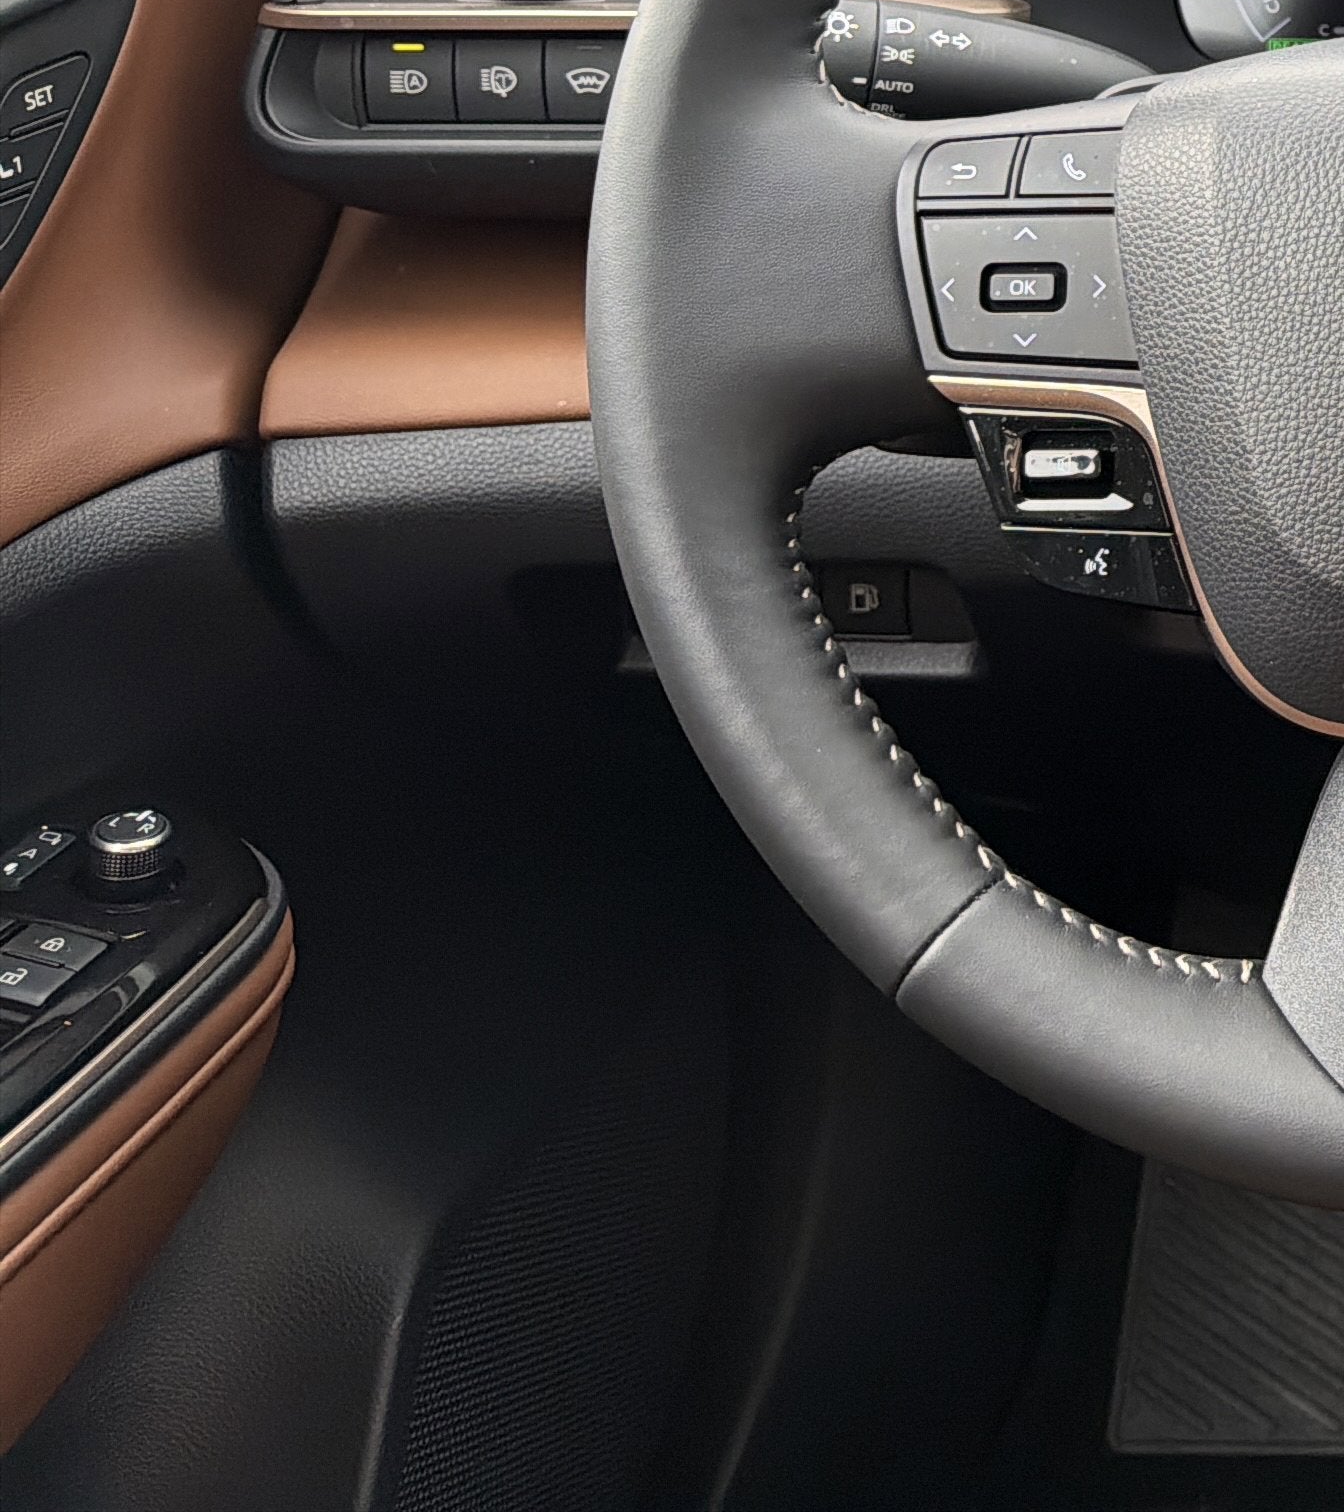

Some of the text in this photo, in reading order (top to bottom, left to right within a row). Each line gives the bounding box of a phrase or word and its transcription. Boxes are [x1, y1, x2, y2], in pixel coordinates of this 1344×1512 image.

[875, 79, 914, 94] AUTO
[24, 85, 54, 111] SET
[1009, 280, 1037, 296] OK
